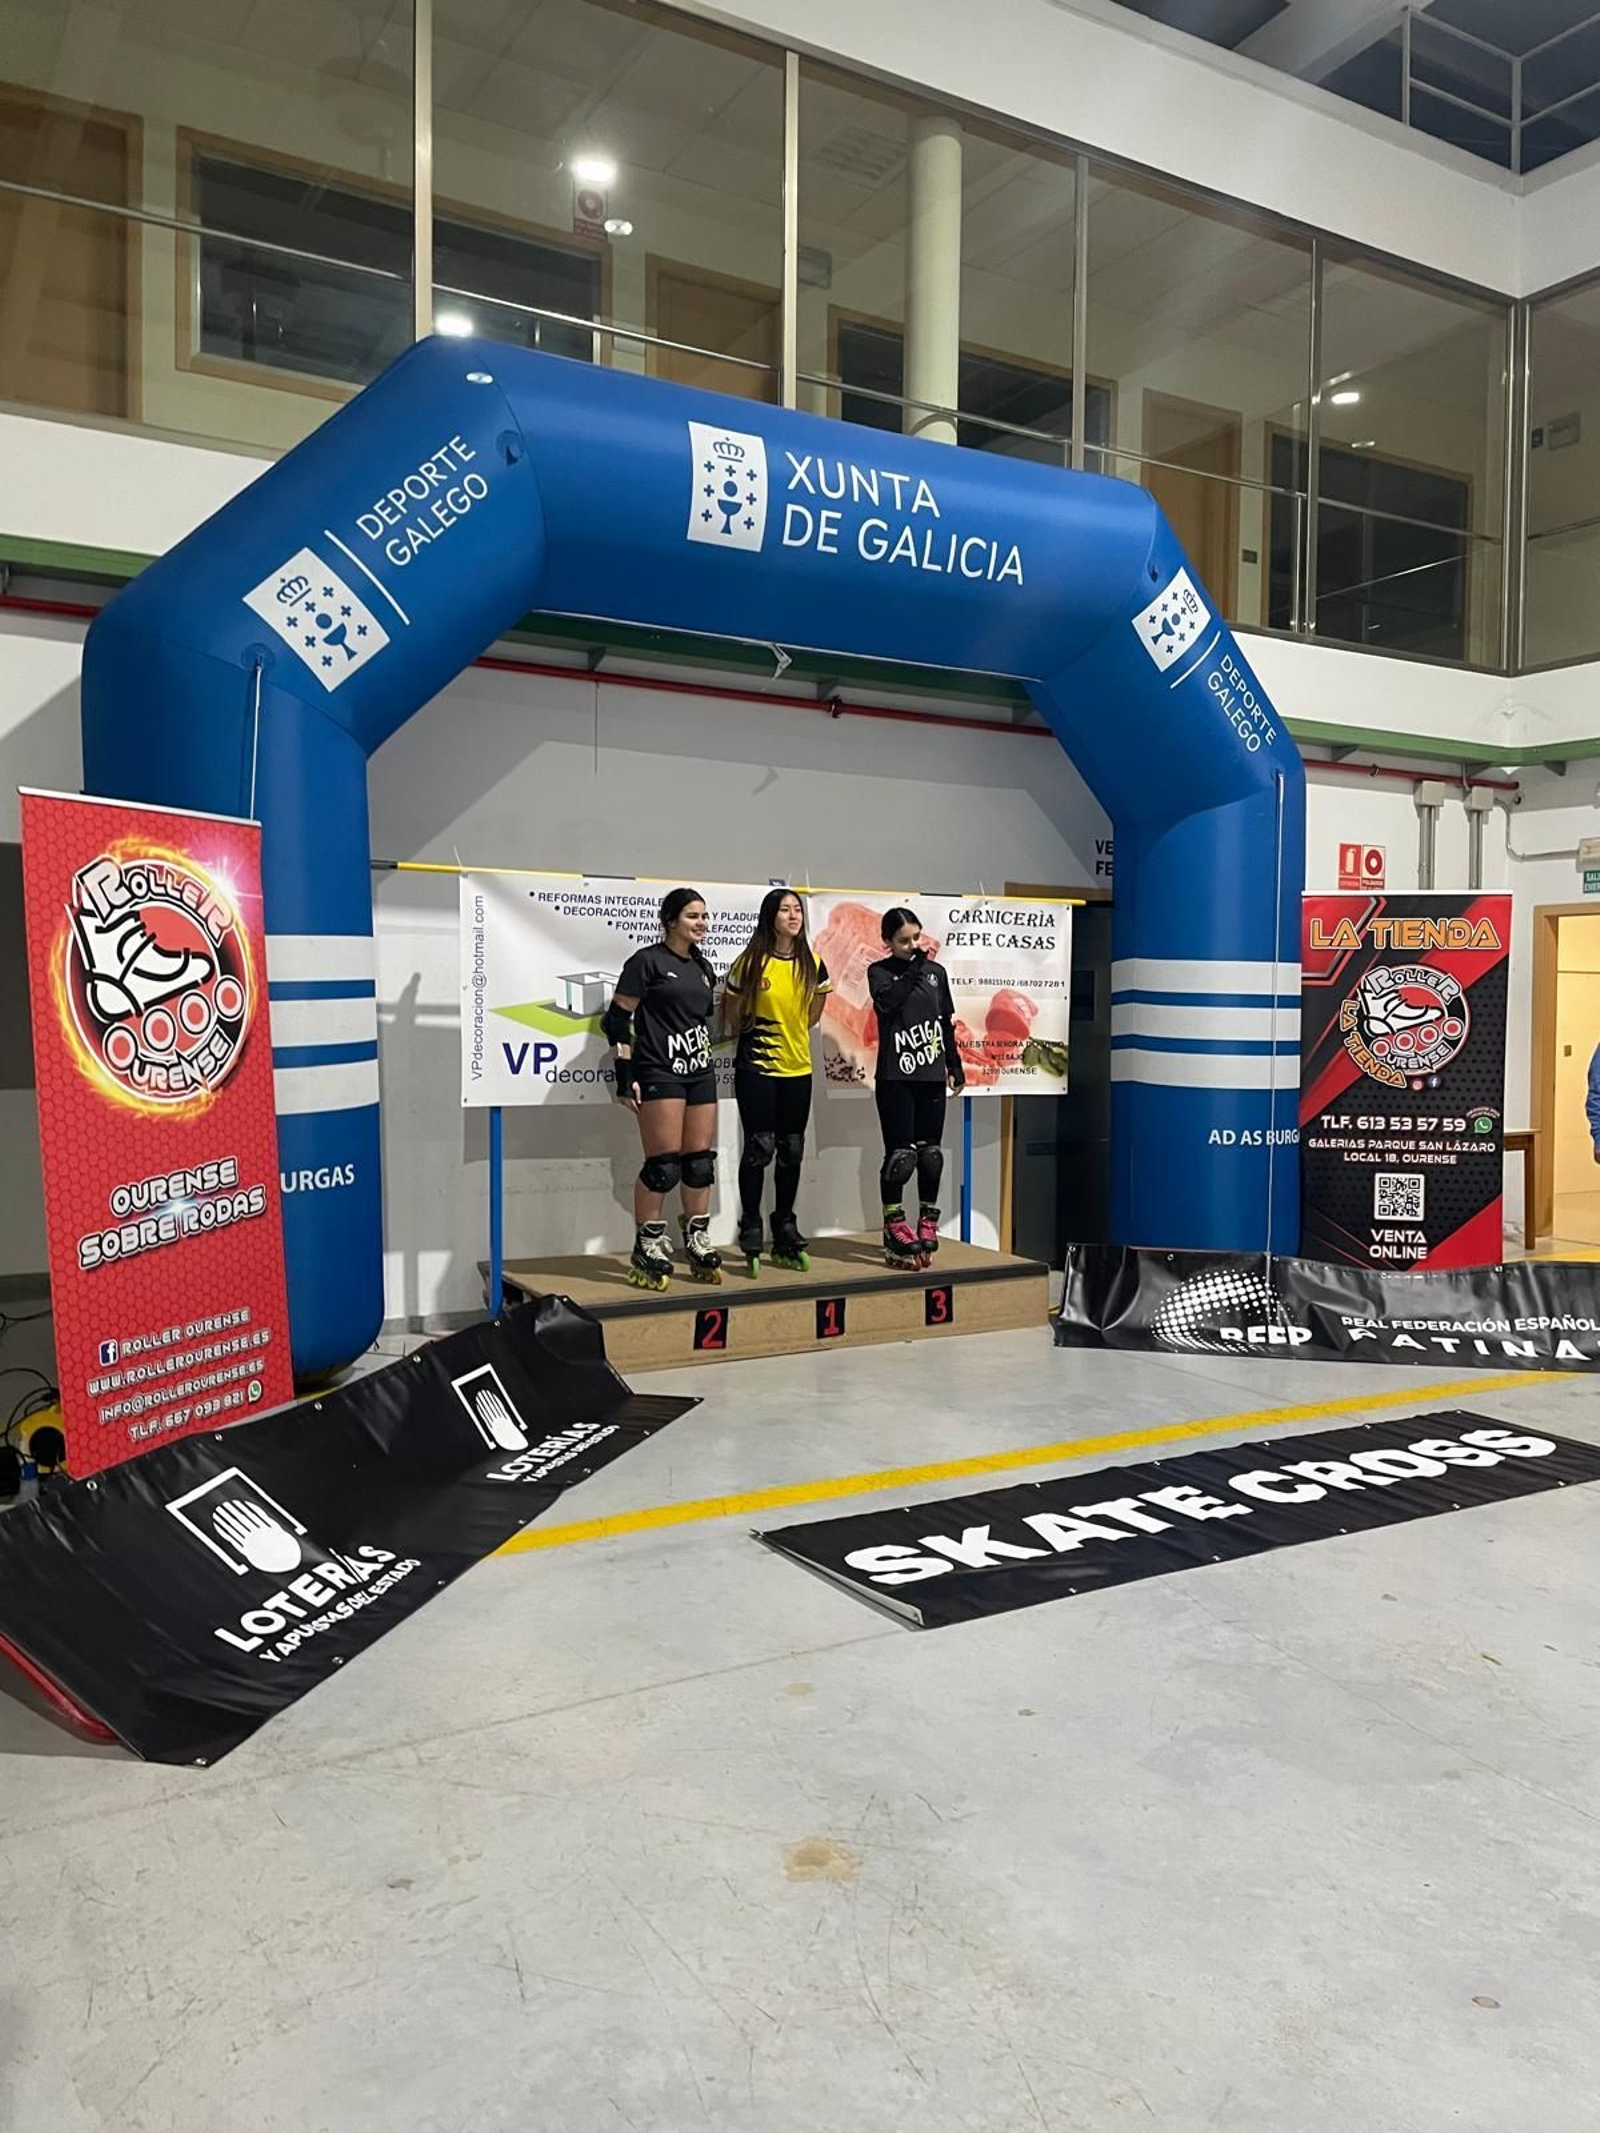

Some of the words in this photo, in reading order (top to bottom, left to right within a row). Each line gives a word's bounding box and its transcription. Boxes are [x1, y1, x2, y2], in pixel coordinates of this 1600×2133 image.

[356, 435, 477, 540] DEPORTE
[784, 451, 941, 518] XUNTA
[385, 473, 488, 566] GALEGO
[782, 503, 842, 554] DE
[857, 518, 1024, 586] GALICIA
[1207, 671, 1261, 752] GALEGO
[1220, 654, 1277, 746] DEPORTE
[81, 858, 235, 941] ROLLER
[538, 891, 601, 905] REFORMAS
[563, 905, 637, 919] DECORACIÓN
[640, 909, 654, 919] EN
[712, 911, 719, 921] Y
[945, 932, 992, 947] PEPE
[996, 934, 1056, 950] CASAS
[1311, 918, 1359, 949] LA
[1368, 918, 1501, 949] TIENDA
[471, 895, 487, 1081] VPdecoracion@hotmail.com
[1366, 966, 1461, 1004] ROLLER
[1340, 1000, 1359, 1032] LA
[103, 1024, 233, 1090] OURENSE
[502, 1042, 558, 1075] VP
[1344, 1032, 1407, 1088] TIENDA
[1370, 1037, 1453, 1070] OURENSE
[1208, 1128, 1237, 1146] AD
[1240, 1129, 1263, 1146] AS
[1265, 1128, 1299, 1146] BURG
[1321, 1115, 1353, 1130] TLF.
[1356, 1116, 1386, 1131] 613
[1390, 1117, 1412, 1131] 53
[1417, 1117, 1439, 1132] 57
[1443, 1118, 1466, 1132] 59
[1308, 1138, 1365, 1149] GALERIAS
[1368, 1139, 1416, 1151] PARQUE
[1418, 1141, 1444, 1151] SAN
[1445, 1140, 1496, 1153] LÁZARO
[1344, 1152, 1382, 1163] LOCAL
[1402, 1154, 1457, 1165] OURENSE
[110, 1156, 238, 1217] OURENSE
[78, 1212, 177, 1269] SOBRE
[180, 1185, 266, 1233] RODAS
[1371, 1228, 1427, 1244] VENTA
[1369, 1244, 1427, 1260] ONLINE
[823, 1301, 840, 1336] 1
[931, 1289, 948, 1323] 3
[1341, 1316, 1389, 1329] REAL
[1391, 1318, 1510, 1333] FEDERACIÓN
[1514, 1314, 1600, 1331] ESPAÑOL
[120, 1327, 182, 1356] ROLLER
[185, 1307, 250, 1339] OURENSE
[701, 1309, 724, 1349] 2
[485, 1422, 601, 1481] LOTERÍAS
[843, 1485, 1254, 1585] SKATE
[1228, 1430, 1556, 1503] CROSS
[259, 1649, 281, 1663] Y
[368, 1558, 422, 1595] ESTADO
